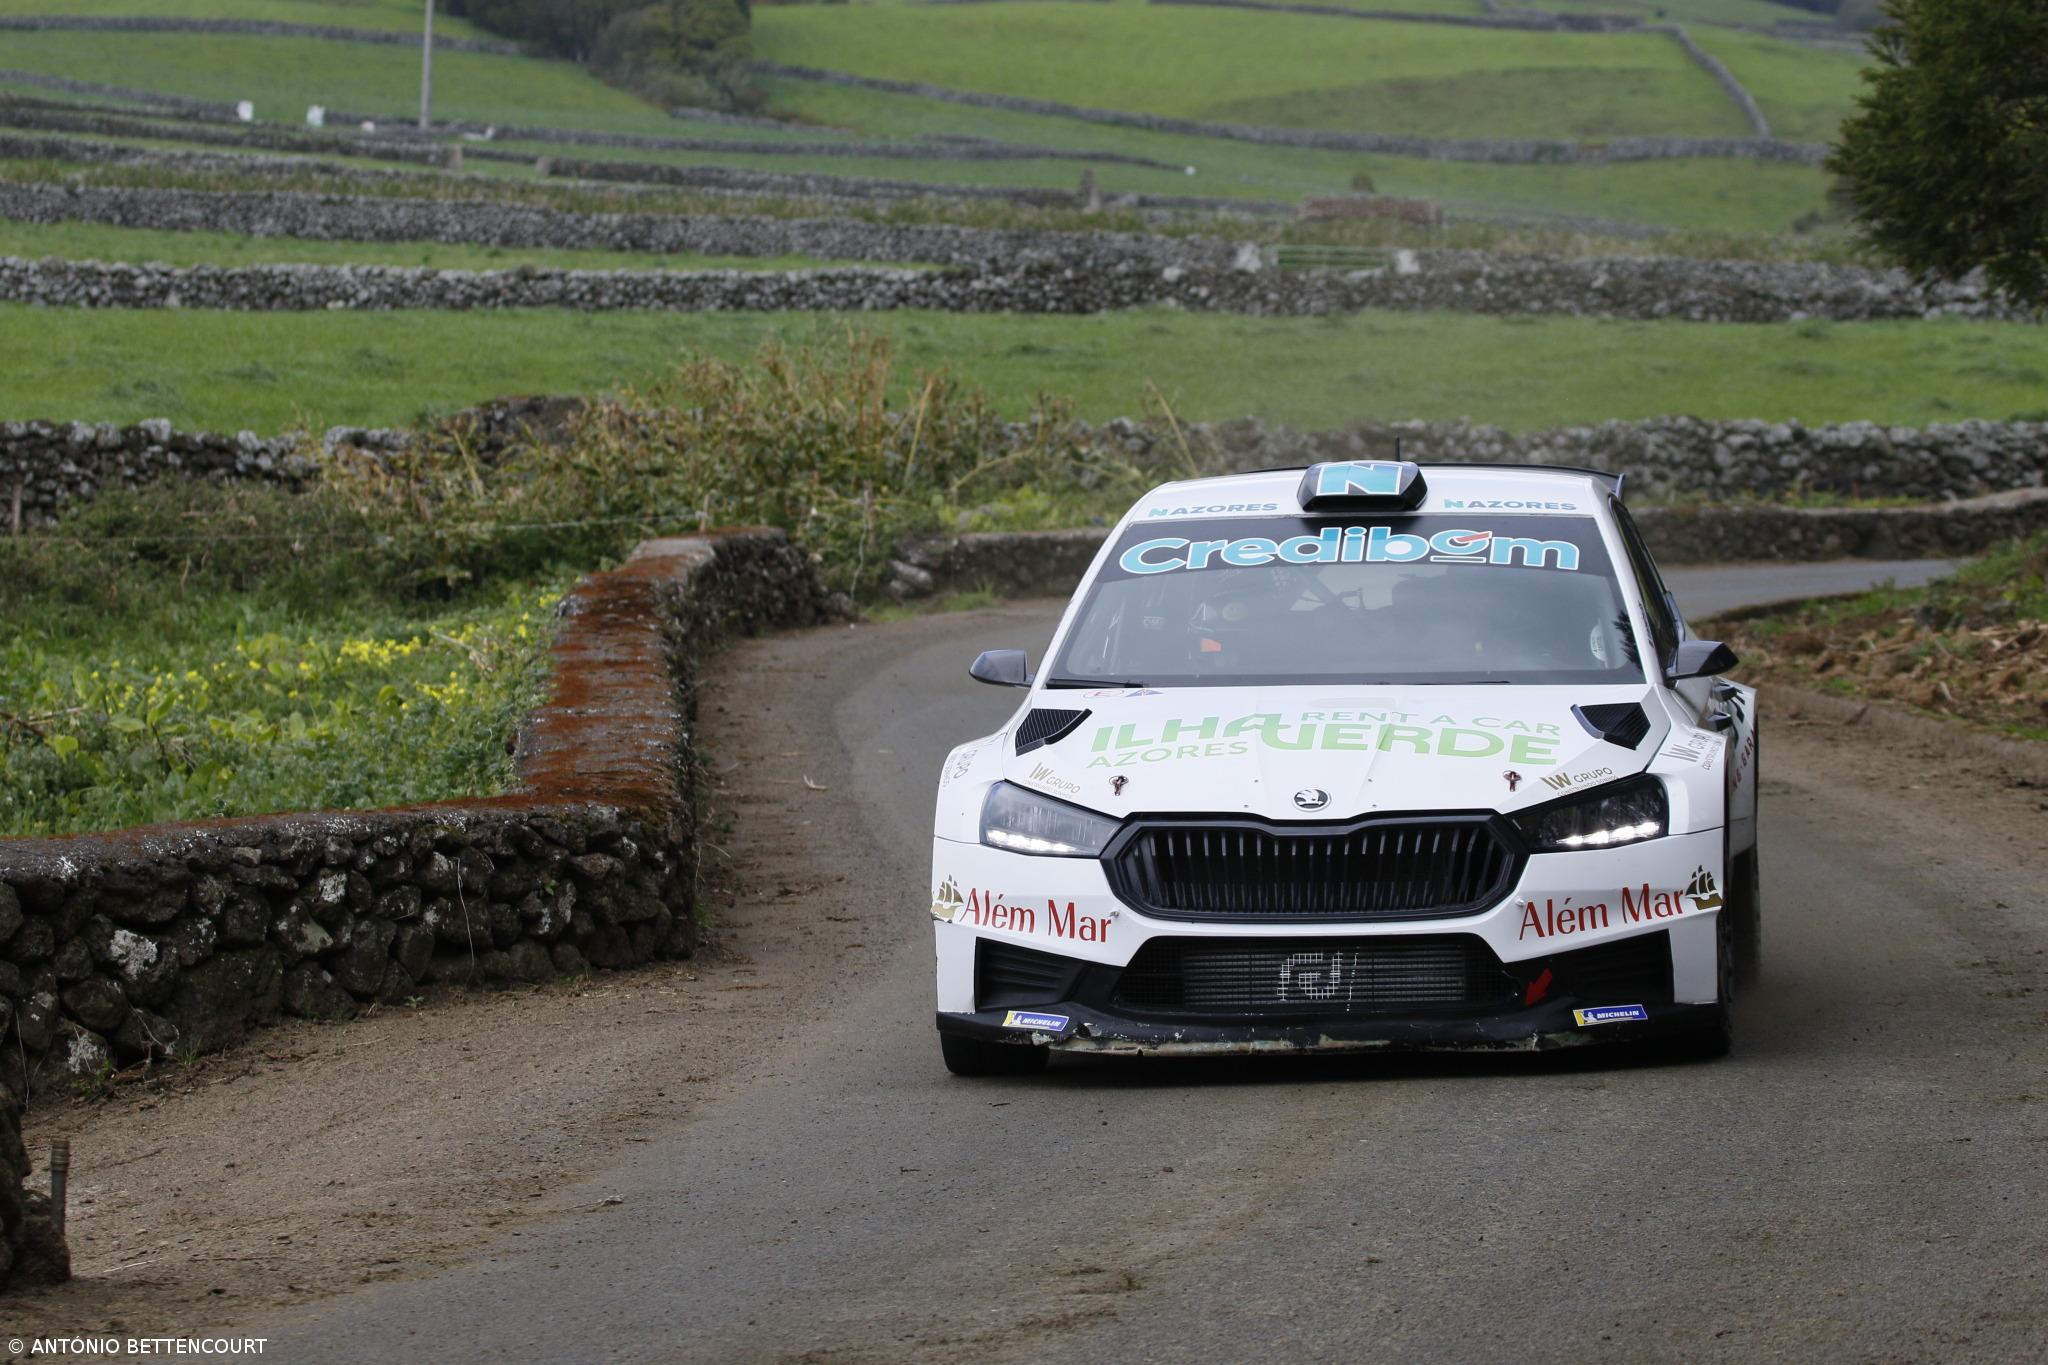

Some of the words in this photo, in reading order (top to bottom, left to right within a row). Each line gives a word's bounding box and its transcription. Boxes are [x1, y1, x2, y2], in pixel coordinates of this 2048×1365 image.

[1119, 525, 1580, 575] Credibom
[1091, 713, 1283, 753] ILHA
[1301, 711, 1419, 723] RENT
[1430, 714, 1457, 725] A
[1472, 717, 1561, 736] CAR
[1086, 741, 1249, 768] AZORES
[1045, 777, 1081, 794] GRUPO
[1573, 767, 1613, 783] GRUPO
[959, 887, 1035, 934] Além
[1047, 899, 1112, 943] Mar
[1519, 896, 1609, 941] Além
[1621, 883, 1684, 924] Mar
[1021, 1017, 1062, 1027] MICHELIN
[1597, 1010, 1640, 1019] MICHELIN
